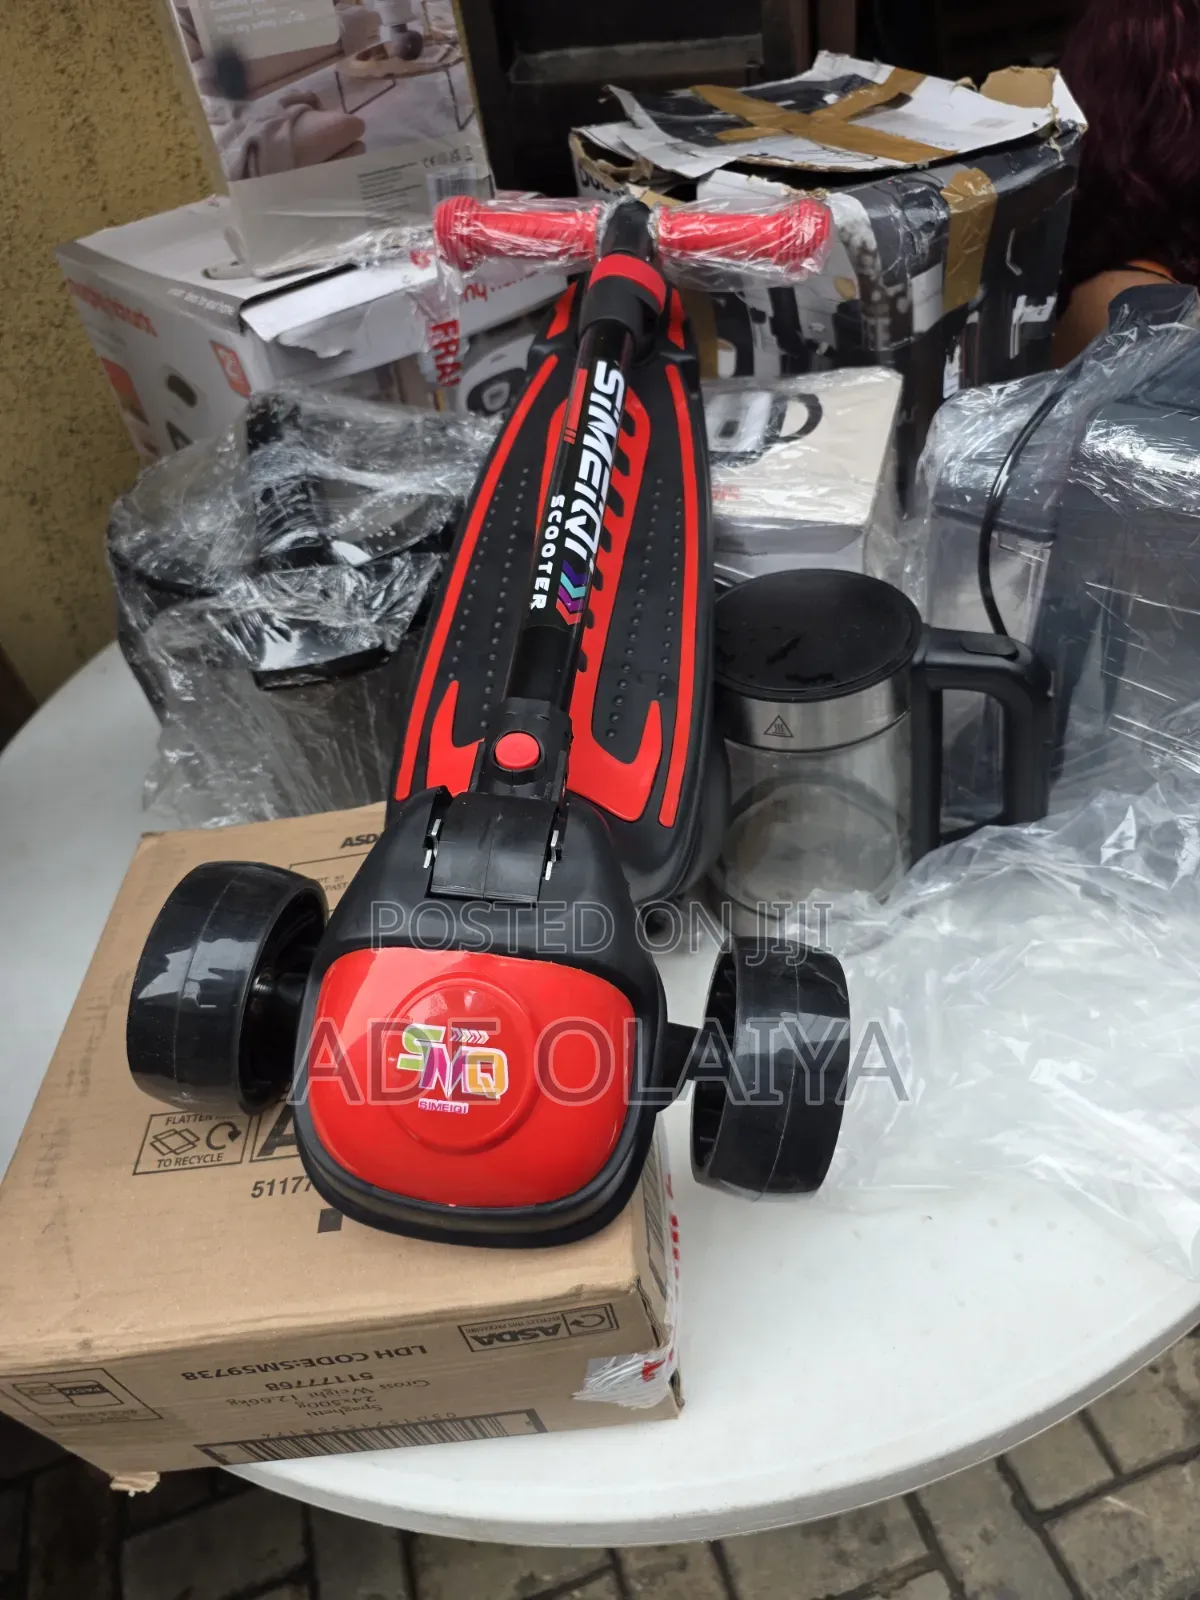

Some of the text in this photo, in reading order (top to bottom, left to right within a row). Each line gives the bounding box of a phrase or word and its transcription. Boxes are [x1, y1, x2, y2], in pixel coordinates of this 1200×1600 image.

[530, 494, 565, 610] SCOOTER
[340, 833, 380, 849] ASD
[396, 1023, 509, 1099] SMQ
[418, 1099, 469, 1114] SIMEIQI
[165, 1113, 213, 1126] FLATTEN
[157, 1153, 224, 1168] TO RECYCLE
[464, 1322, 507, 1334] PACKAGING
[469, 1322, 562, 1346] ASDA
[180, 1344, 428, 1381] LDH CODE:SM59738
[265, 1372, 374, 1391] 51177768
[379, 1379, 431, 1390] Gross
[306, 1385, 375, 1399] Weight
[297, 1394, 377, 1409] 24x500g
[307, 1403, 384, 1419] Spaghetti
